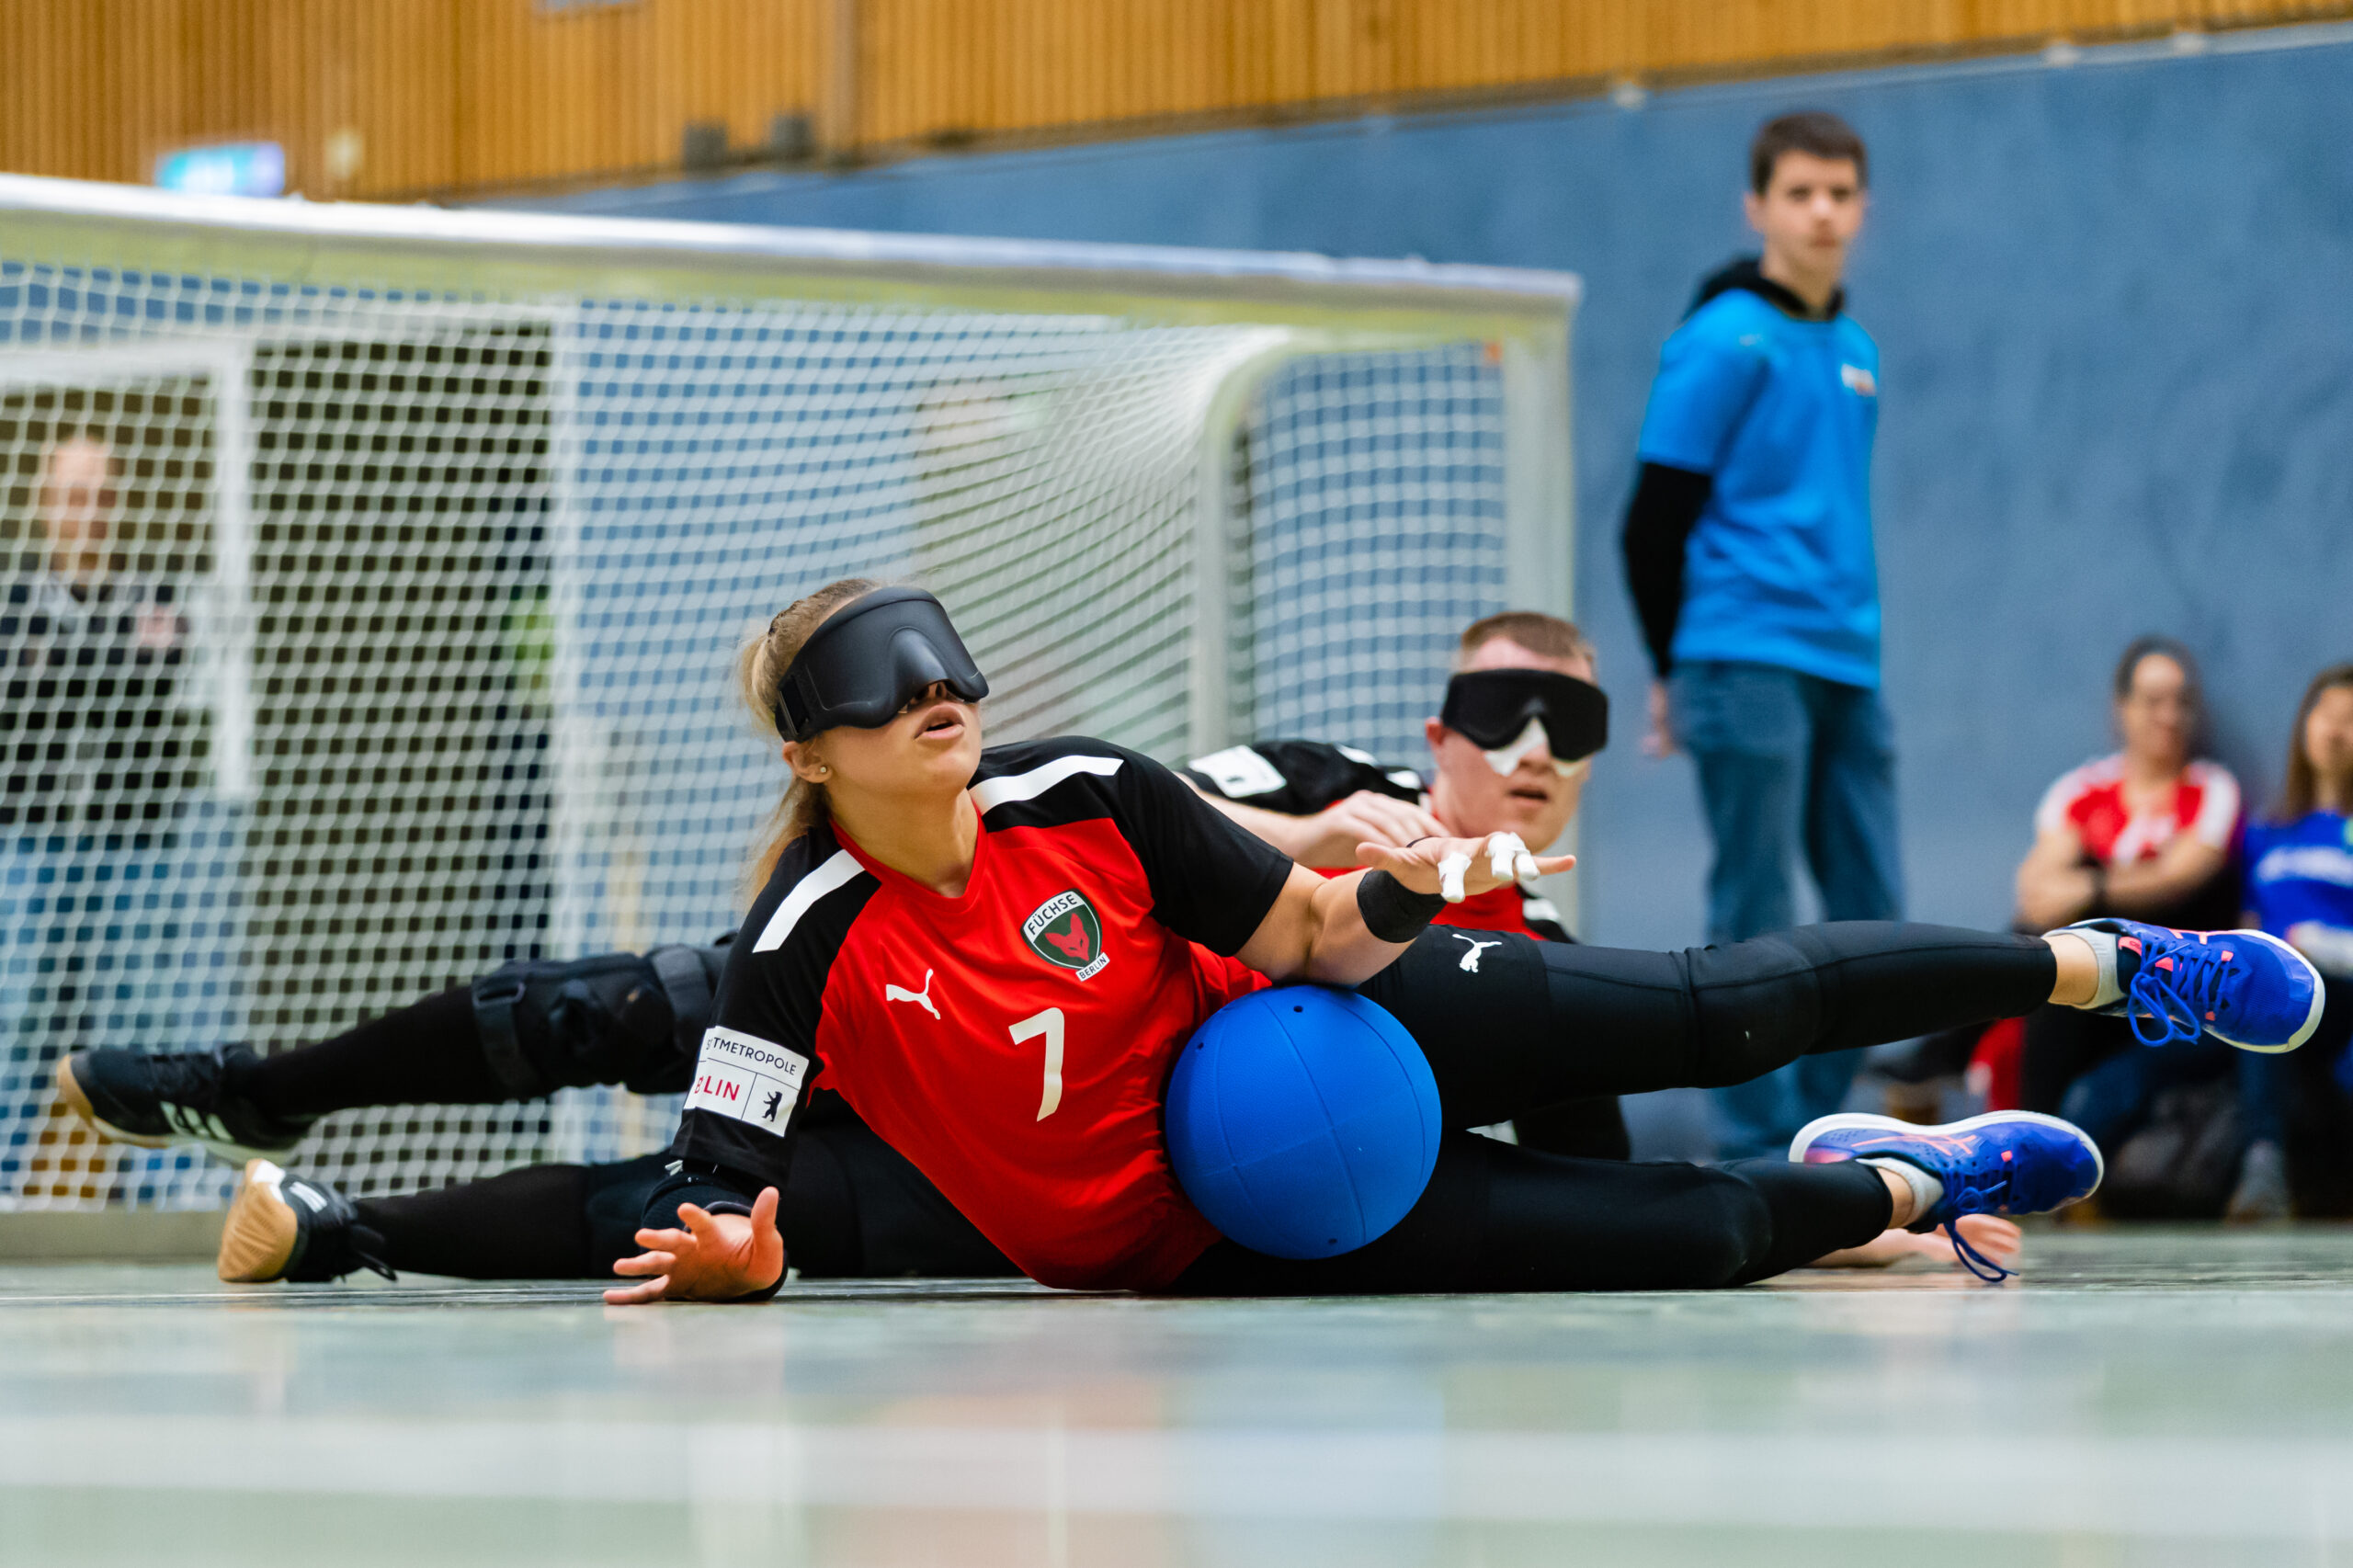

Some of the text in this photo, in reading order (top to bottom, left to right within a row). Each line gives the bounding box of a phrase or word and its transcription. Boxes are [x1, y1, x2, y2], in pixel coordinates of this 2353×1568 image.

[1028, 894, 1077, 936] FÜCHSE
[1078, 956, 1108, 980] BERLIN
[706, 1037, 797, 1076] TMETROPOLE
[1007, 1006, 1065, 1122] 7
